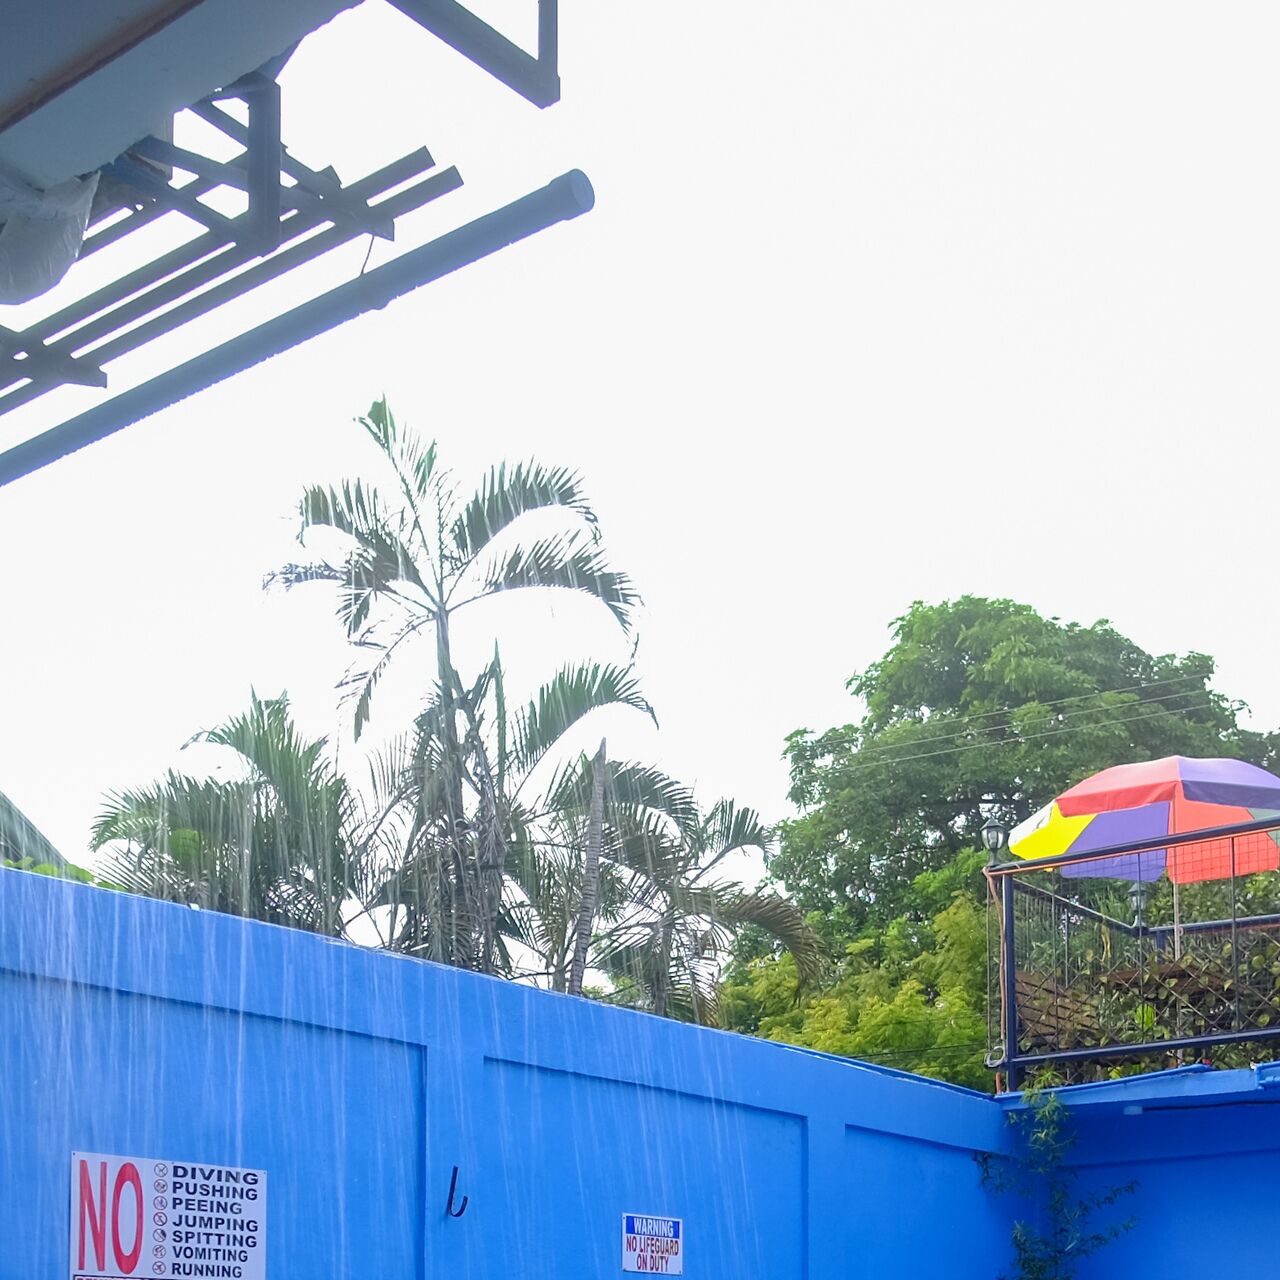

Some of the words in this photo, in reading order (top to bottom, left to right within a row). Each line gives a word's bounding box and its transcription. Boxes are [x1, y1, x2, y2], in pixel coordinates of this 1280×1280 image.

[172, 1166, 259, 1185] DIVING
[172, 1182, 258, 1201] PUSHING
[172, 1198, 242, 1214] PEEING
[78, 1160, 143, 1274] NO
[172, 1215, 258, 1232] JUMPING
[634, 1218, 674, 1237] WARNING
[172, 1231, 257, 1248] SPITTING
[626, 1235, 637, 1252] NO
[639, 1237, 679, 1256] LIFEGUARD
[172, 1246, 248, 1262] VOMITING
[637, 1254, 647, 1270] ON
[650, 1256, 669, 1272] DUTY
[172, 1263, 242, 1278] RUNNING
